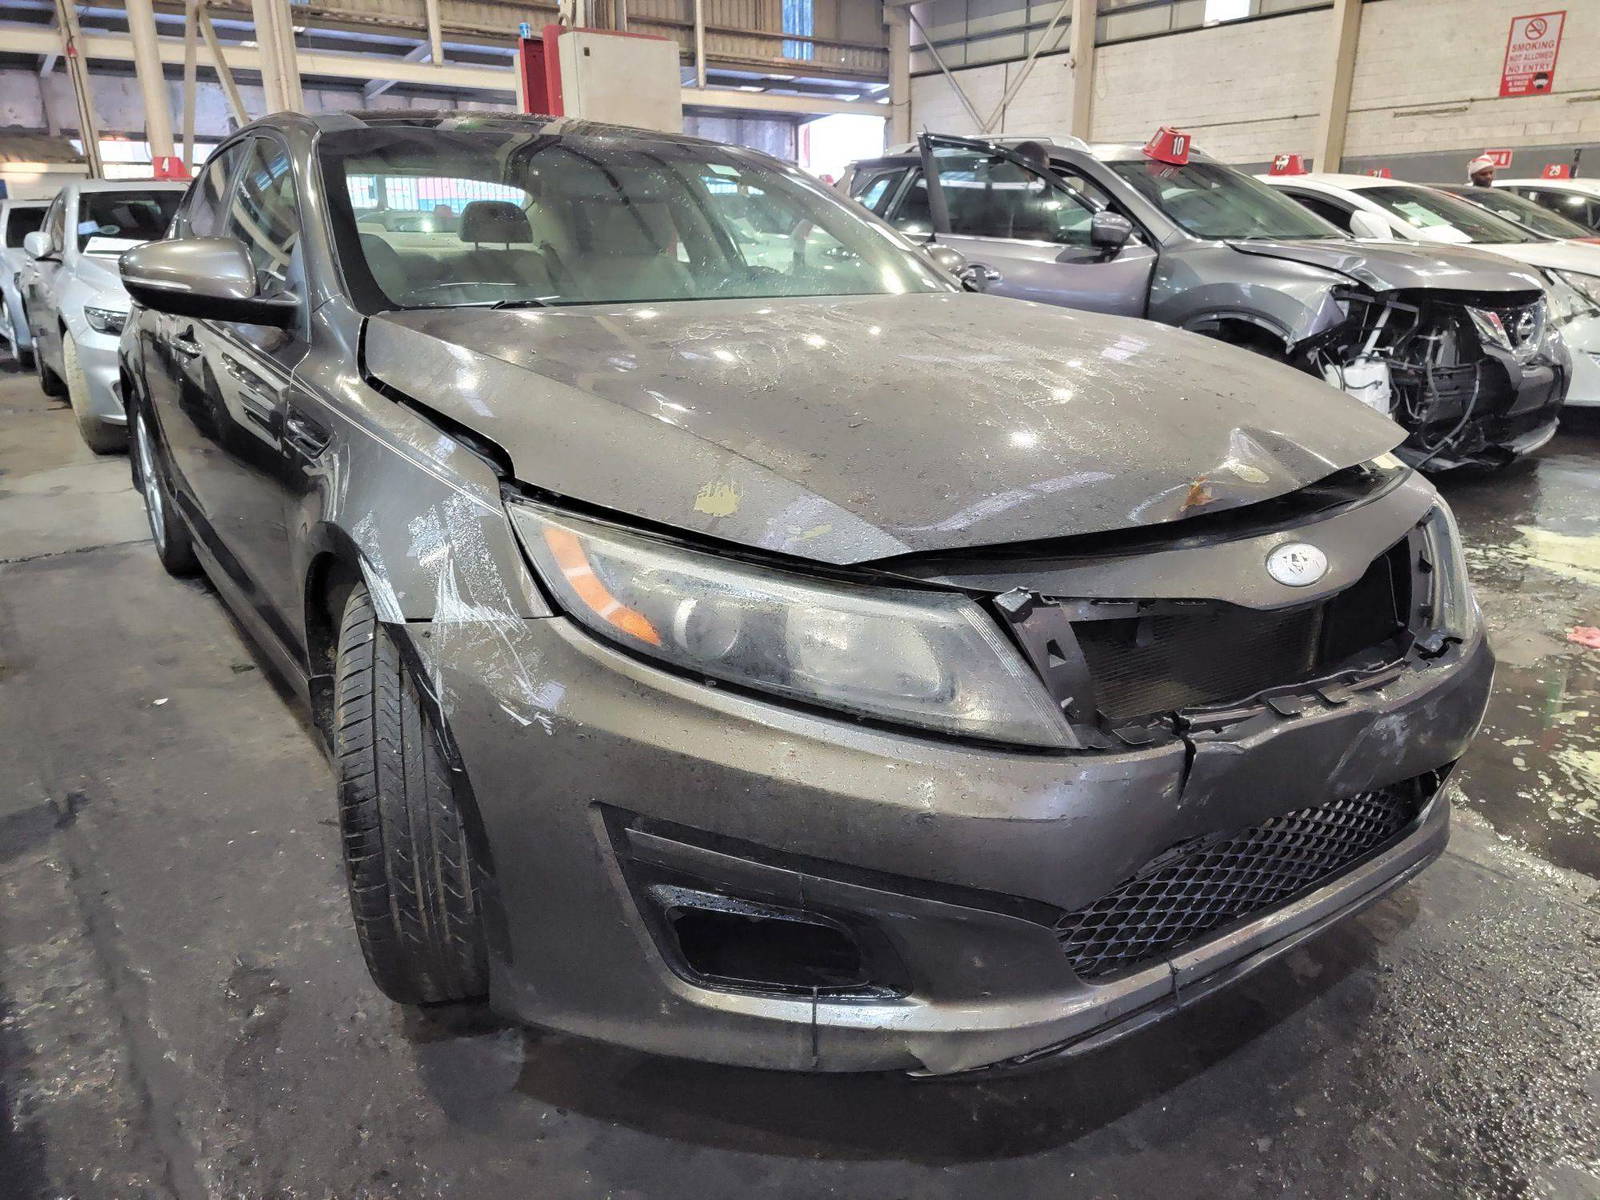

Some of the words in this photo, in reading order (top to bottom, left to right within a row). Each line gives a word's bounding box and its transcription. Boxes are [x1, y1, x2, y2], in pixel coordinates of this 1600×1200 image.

[1512, 40, 1555, 52] SMOKING
[1509, 53, 1522, 61] NOT
[1523, 51, 1554, 60] ALLOWED
[1508, 64, 1520, 73] NO
[1522, 63, 1551, 72] ENTRY
[1173, 136, 1184, 155] 10
[161, 157, 169, 172] 4
